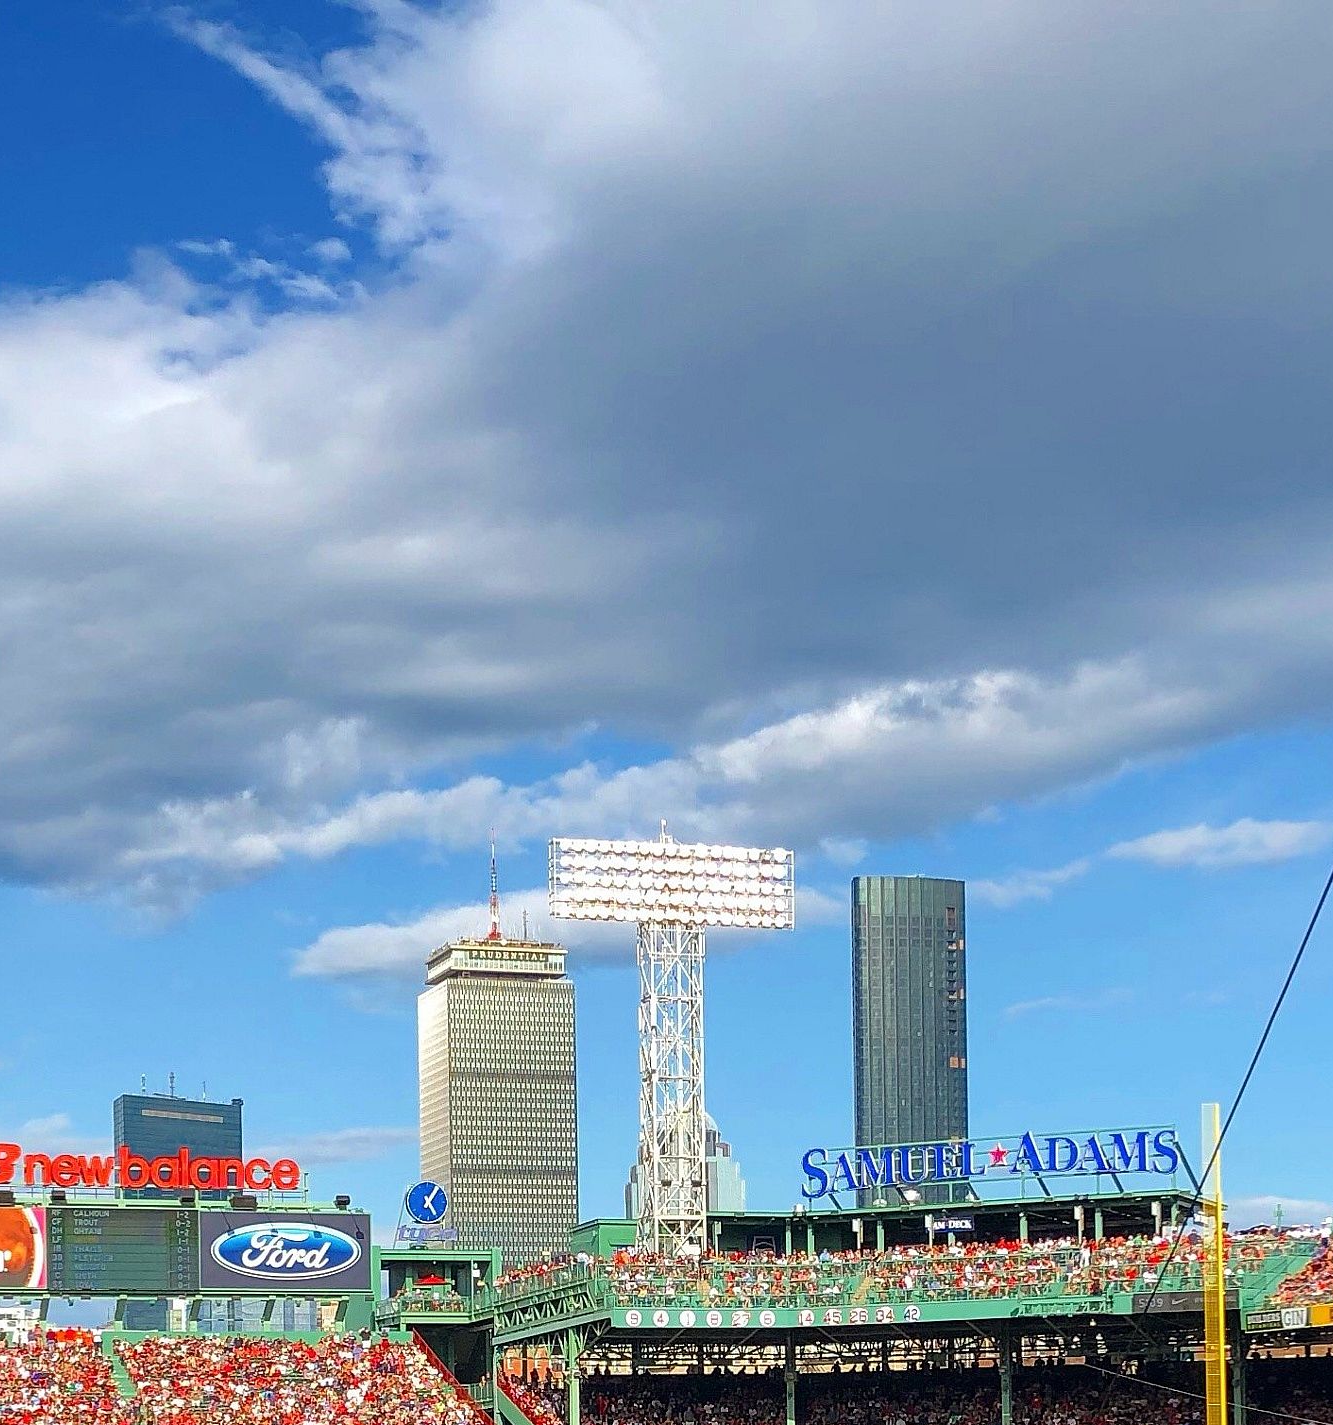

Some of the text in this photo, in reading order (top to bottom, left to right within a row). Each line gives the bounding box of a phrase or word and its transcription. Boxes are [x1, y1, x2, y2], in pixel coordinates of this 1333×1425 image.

[23, 1145, 301, 1190] new balance
[802, 1130, 1180, 1199] SAMUEL ADAMS
[73, 1209, 110, 1217] CALHOUN
[74, 1218, 98, 1226] TROUT
[242, 1229, 332, 1269] Ford
[797, 1311, 813, 1326] 14
[823, 1310, 842, 1325] 45
[849, 1310, 868, 1323] 26
[875, 1309, 894, 1322] 34
[903, 1307, 919, 1321] 42
[1283, 1309, 1305, 1327] GIN
